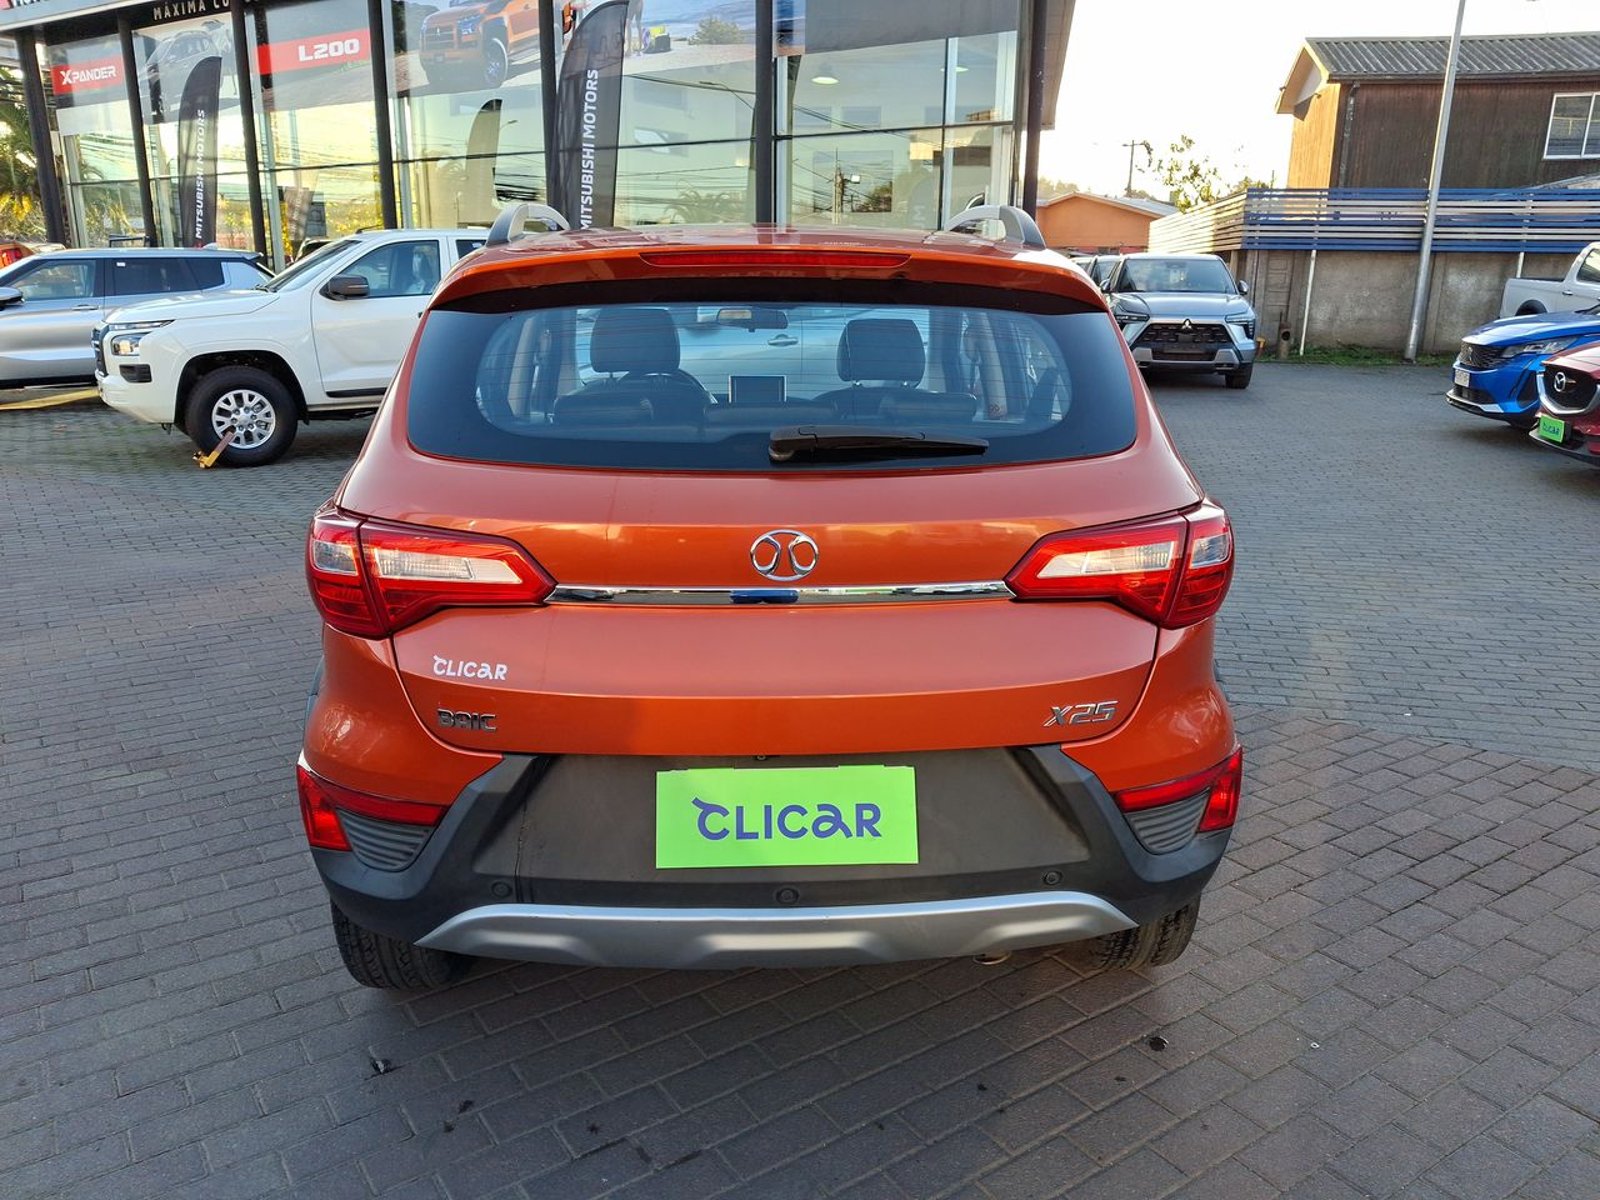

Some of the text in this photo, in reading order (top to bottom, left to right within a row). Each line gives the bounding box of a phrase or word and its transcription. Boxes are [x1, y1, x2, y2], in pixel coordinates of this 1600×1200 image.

[298, 38, 360, 62] L200
[59, 65, 117, 86] XPANDER
[579, 69, 599, 230] MITSUBISHI MOTORS
[195, 109, 205, 239] MITSUBISHI MOTORS
[437, 708, 497, 732] BAIC
[1042, 700, 1119, 727] X25
